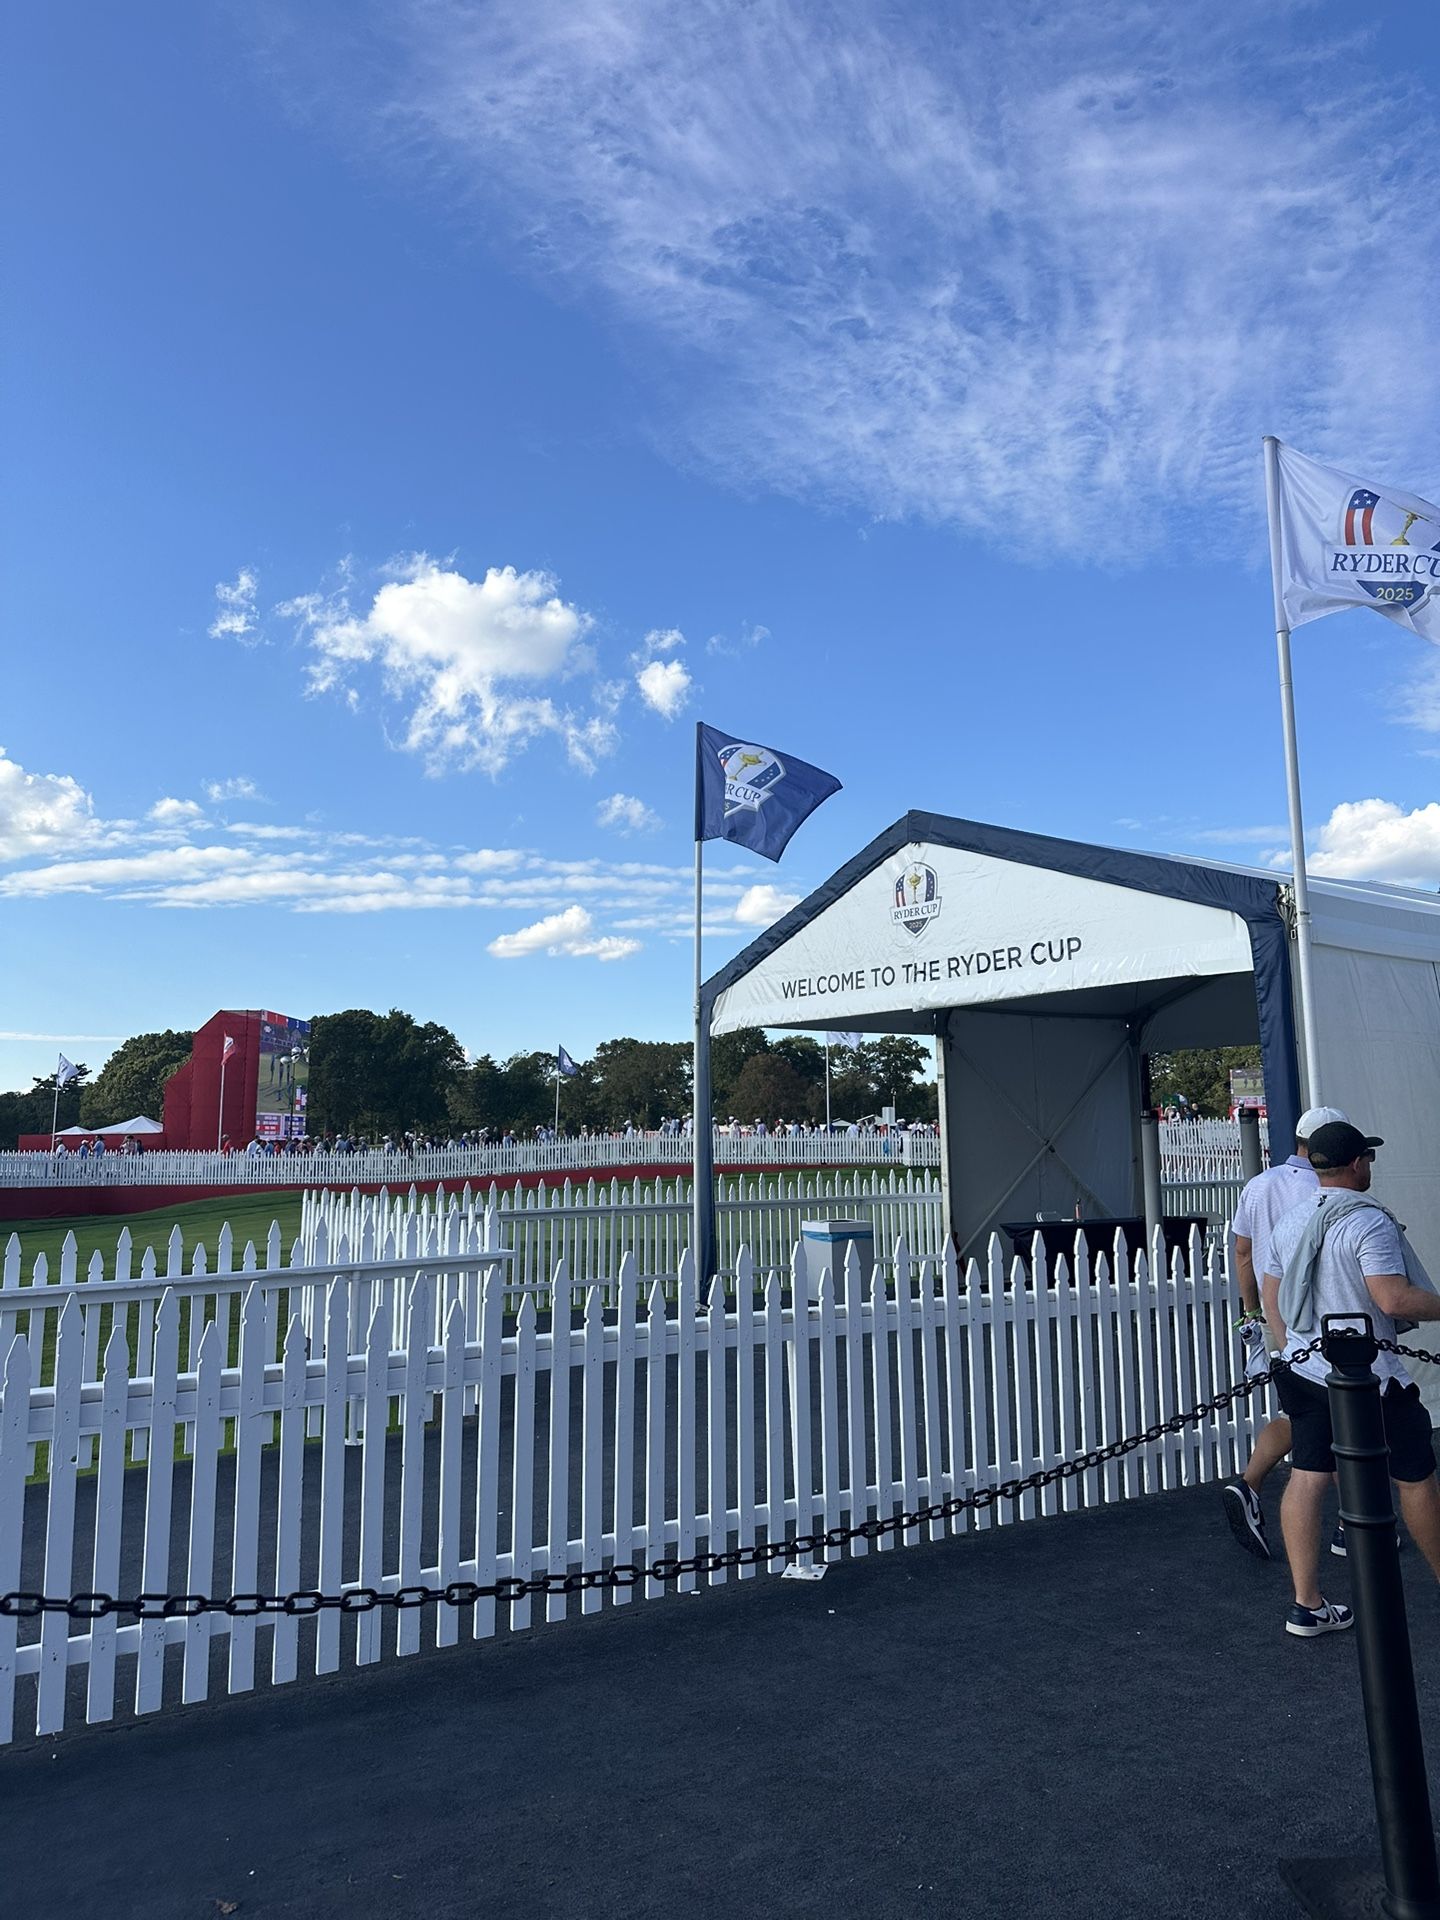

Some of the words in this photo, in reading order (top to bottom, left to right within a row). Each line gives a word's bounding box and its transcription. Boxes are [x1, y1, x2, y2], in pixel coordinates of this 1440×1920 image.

[1331, 552, 1411, 573] RYDER
[1376, 587, 1415, 602] 2025
[735, 786, 761, 802] CUP
[893, 907, 920, 920] RYDER
[921, 903, 938, 915] CUP
[908, 920, 923, 929] 2025
[782, 970, 866, 999] WELCOME
[871, 966, 896, 987] TO
[902, 960, 941, 983] THE
[947, 946, 1022, 979] RYDER
[1030, 936, 1082, 965] CUP
